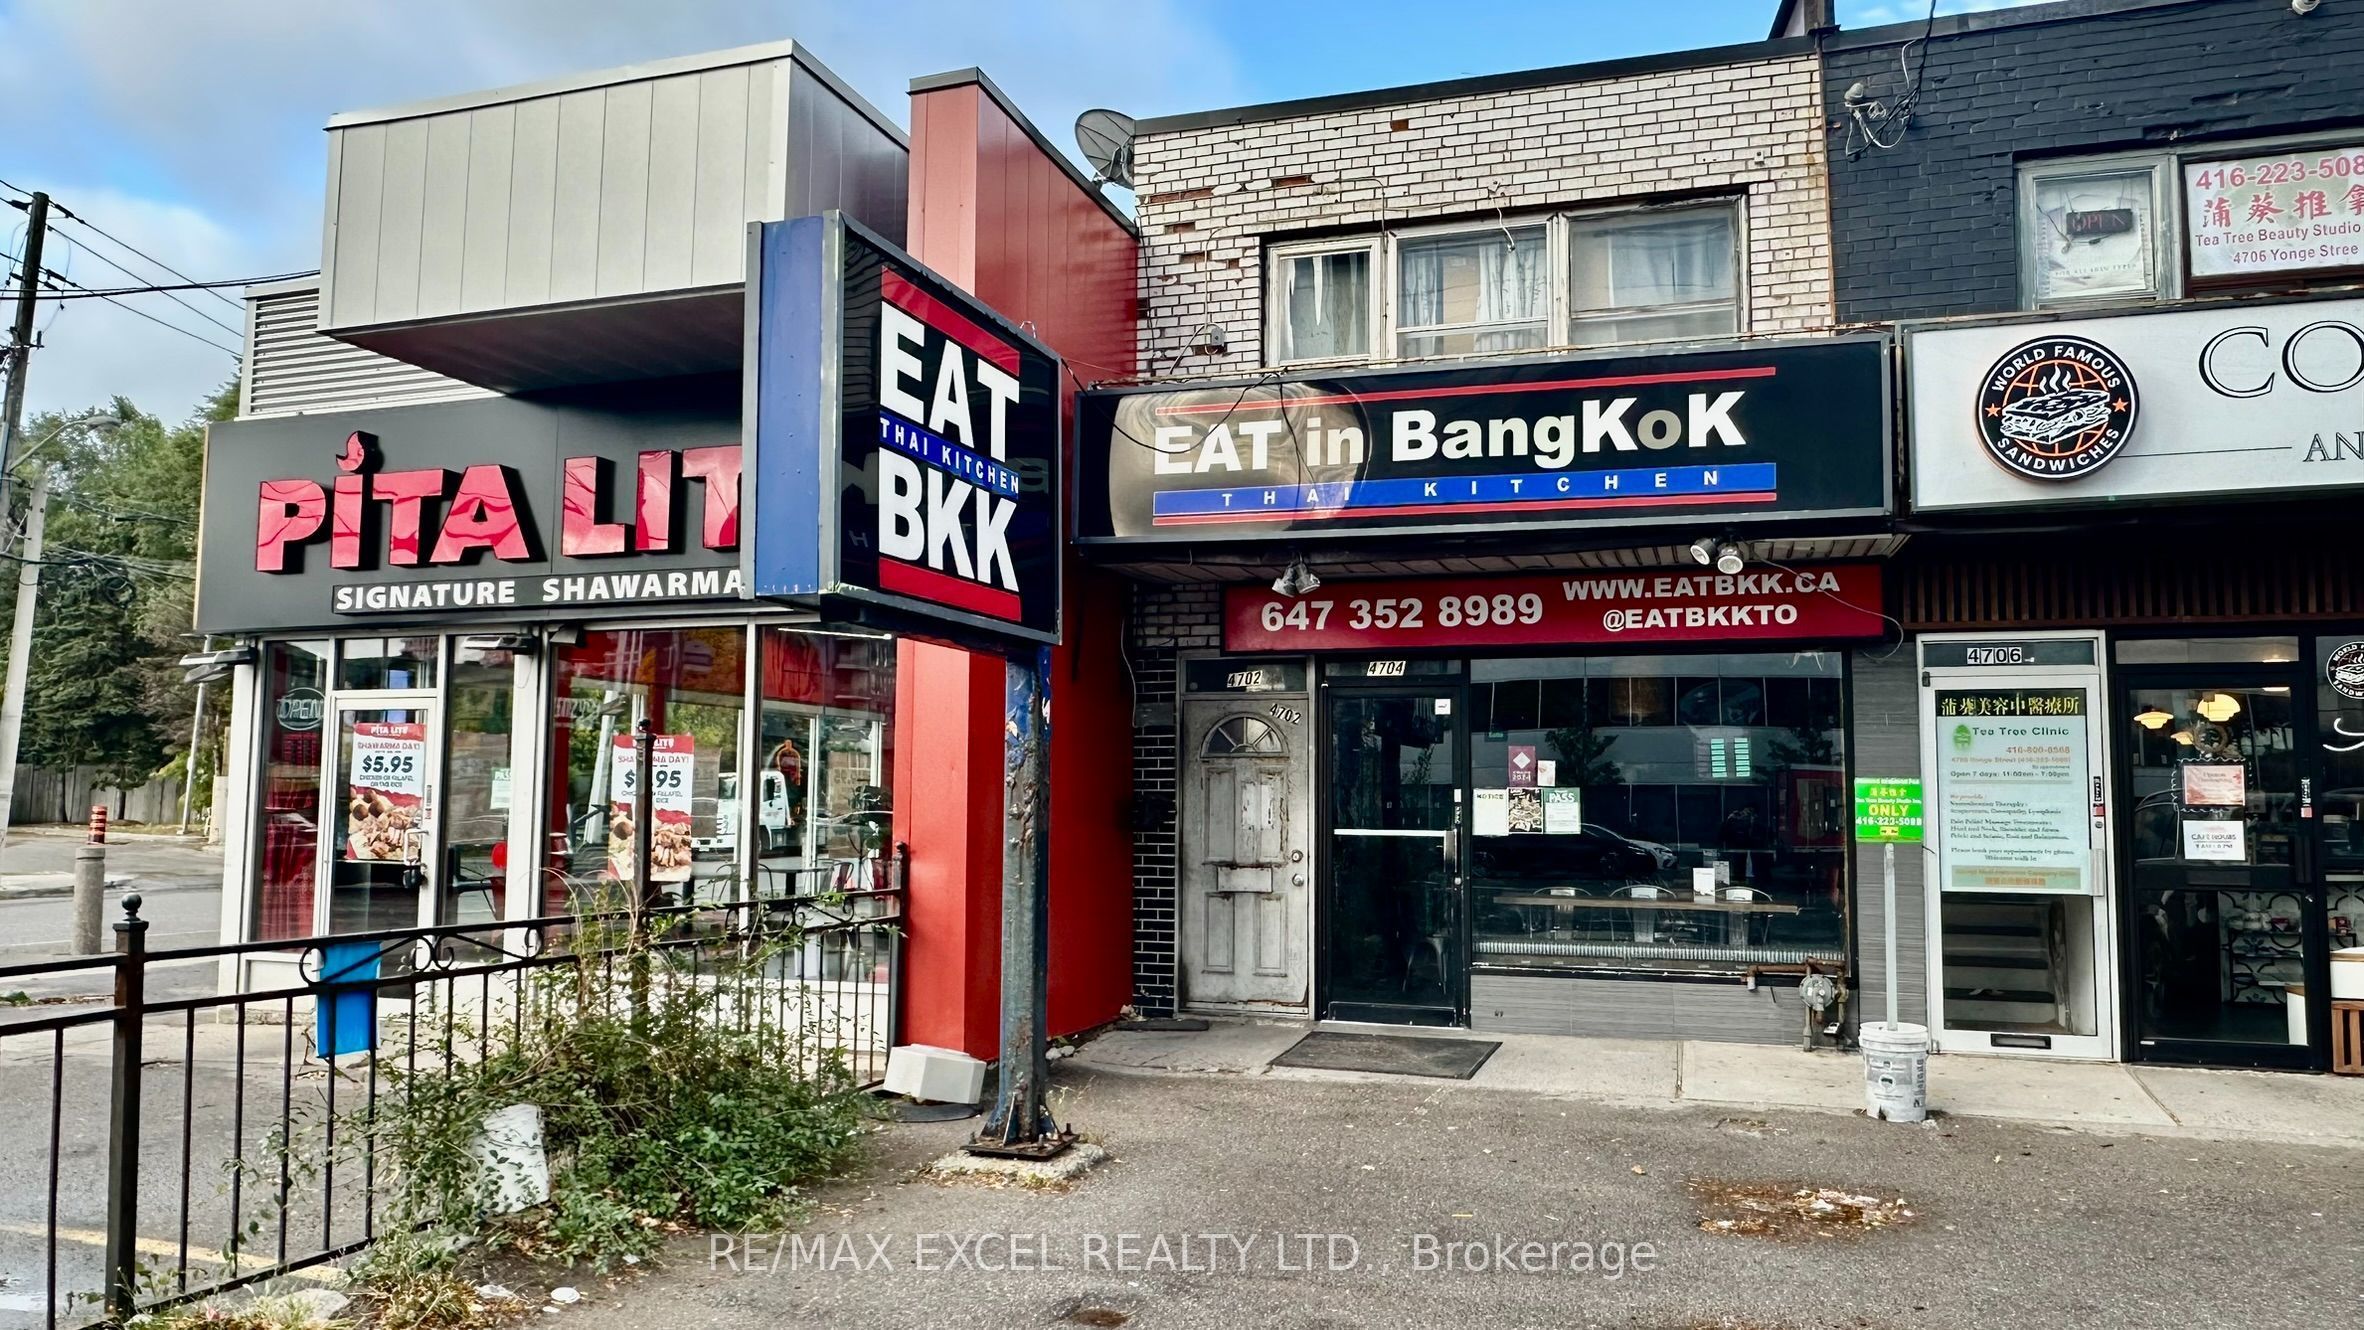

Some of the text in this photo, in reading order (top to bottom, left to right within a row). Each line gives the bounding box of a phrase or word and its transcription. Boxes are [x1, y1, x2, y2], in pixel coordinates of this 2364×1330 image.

[2195, 221, 2361, 247] Tea Tree Beauty Studio
[2233, 250, 2267, 264] 4706
[2270, 247, 2315, 262] Yonge
[1992, 345, 2120, 391] WORLD FAMOUS
[2199, 320, 2364, 398] CO
[879, 300, 1020, 463] EAT
[1154, 391, 1747, 475] EAT in BangKoK
[880, 417, 1020, 494] THAI KITCHEN
[1997, 428, 2119, 472] SANDWICHES
[1222, 471, 1718, 507] THAI KITCHEN
[879, 447, 1020, 592] BKK
[336, 567, 742, 610] SIGNATURE SHAWARMA
[1562, 572, 1840, 601] WWW.EATBKK.CA
[1261, 593, 1543, 632] 647 352 8989
[1603, 604, 1797, 632] @EATBKKTO
[1967, 648, 2021, 663] 4706
[2333, 644, 2358, 662] WORLD
[1228, 670, 1262, 687] 4702
[1369, 661, 1405, 675] 4704
[279, 698, 321, 719] OPEN
[1269, 703, 1301, 725] 4702
[1973, 727, 2070, 736] Tea Tree Clinic
[362, 755, 413, 773] $5.95
[1549, 792, 1575, 803] PASS
[1868, 804, 1909, 817] ONLY
